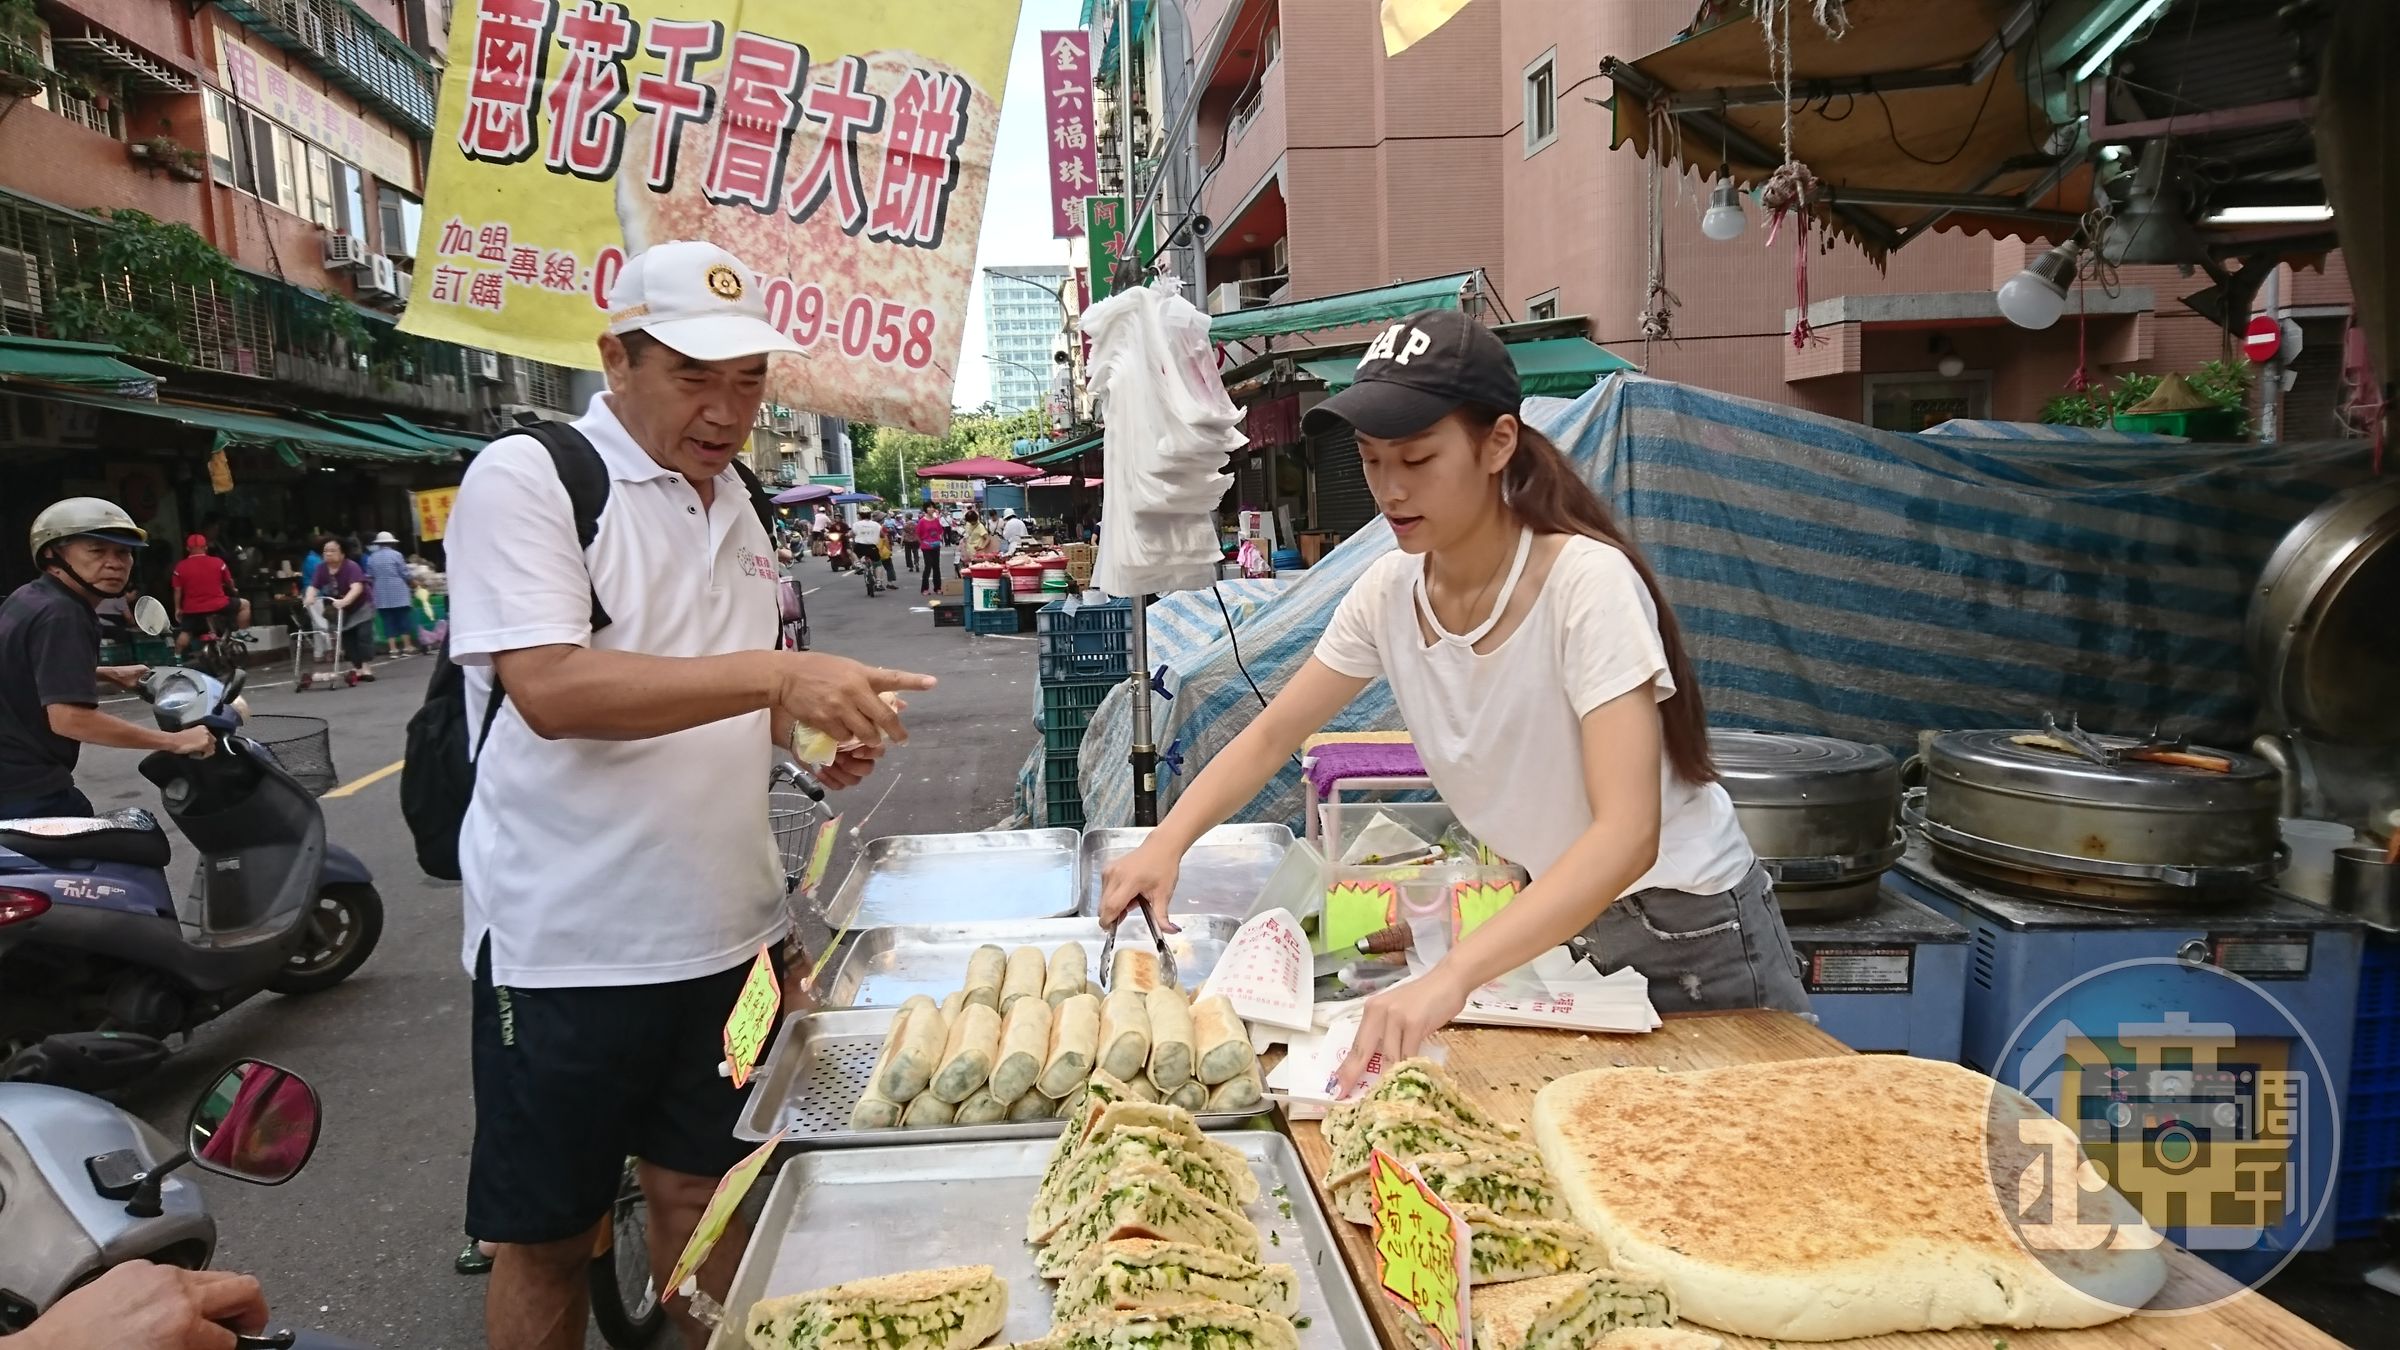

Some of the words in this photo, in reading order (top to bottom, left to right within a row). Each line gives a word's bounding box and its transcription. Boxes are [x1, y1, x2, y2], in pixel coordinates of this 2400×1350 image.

[1051, 36, 1092, 232] 金六福珠寶
[440, 219, 507, 262] 加盟
[1094, 201, 1141, 285] 阿水
[432, 265, 502, 310] 訂購
